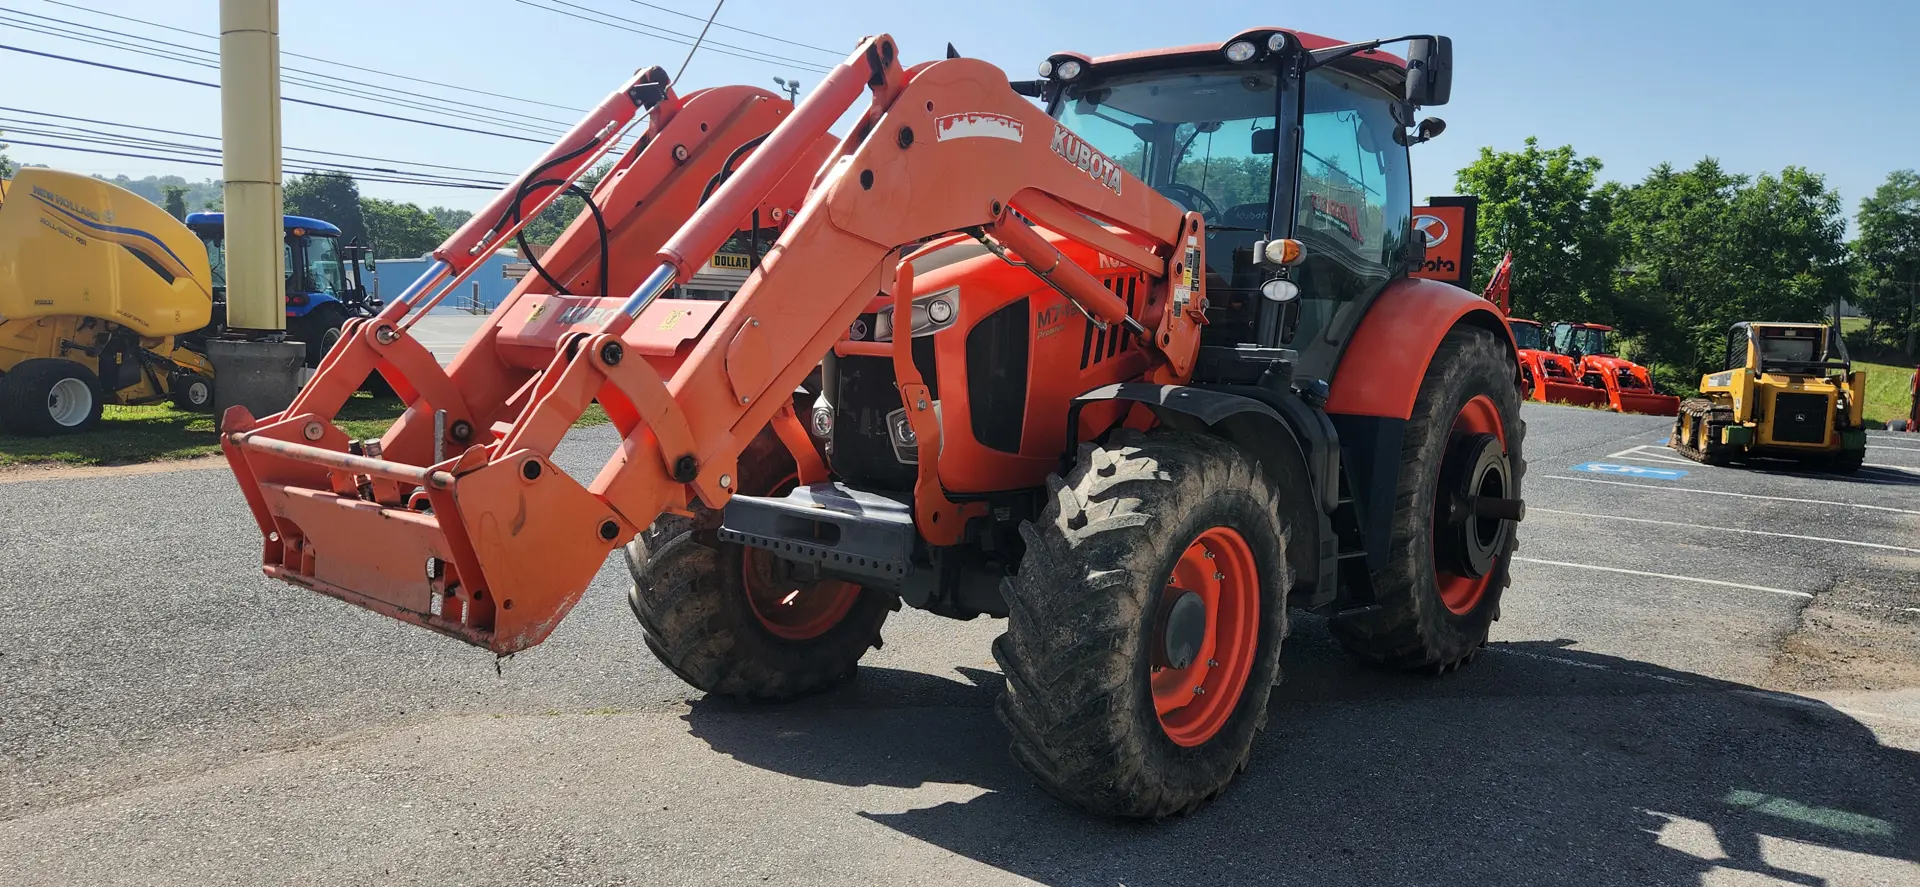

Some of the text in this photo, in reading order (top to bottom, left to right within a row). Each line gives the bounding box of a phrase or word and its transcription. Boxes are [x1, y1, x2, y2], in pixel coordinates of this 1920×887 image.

[1051, 124, 1121, 196] KUBOTA
[33, 184, 100, 222] NEW HOLLAND
[714, 255, 748, 269] DOLLAR
[1422, 256, 1455, 272] ota
[555, 306, 620, 326] KUBO
